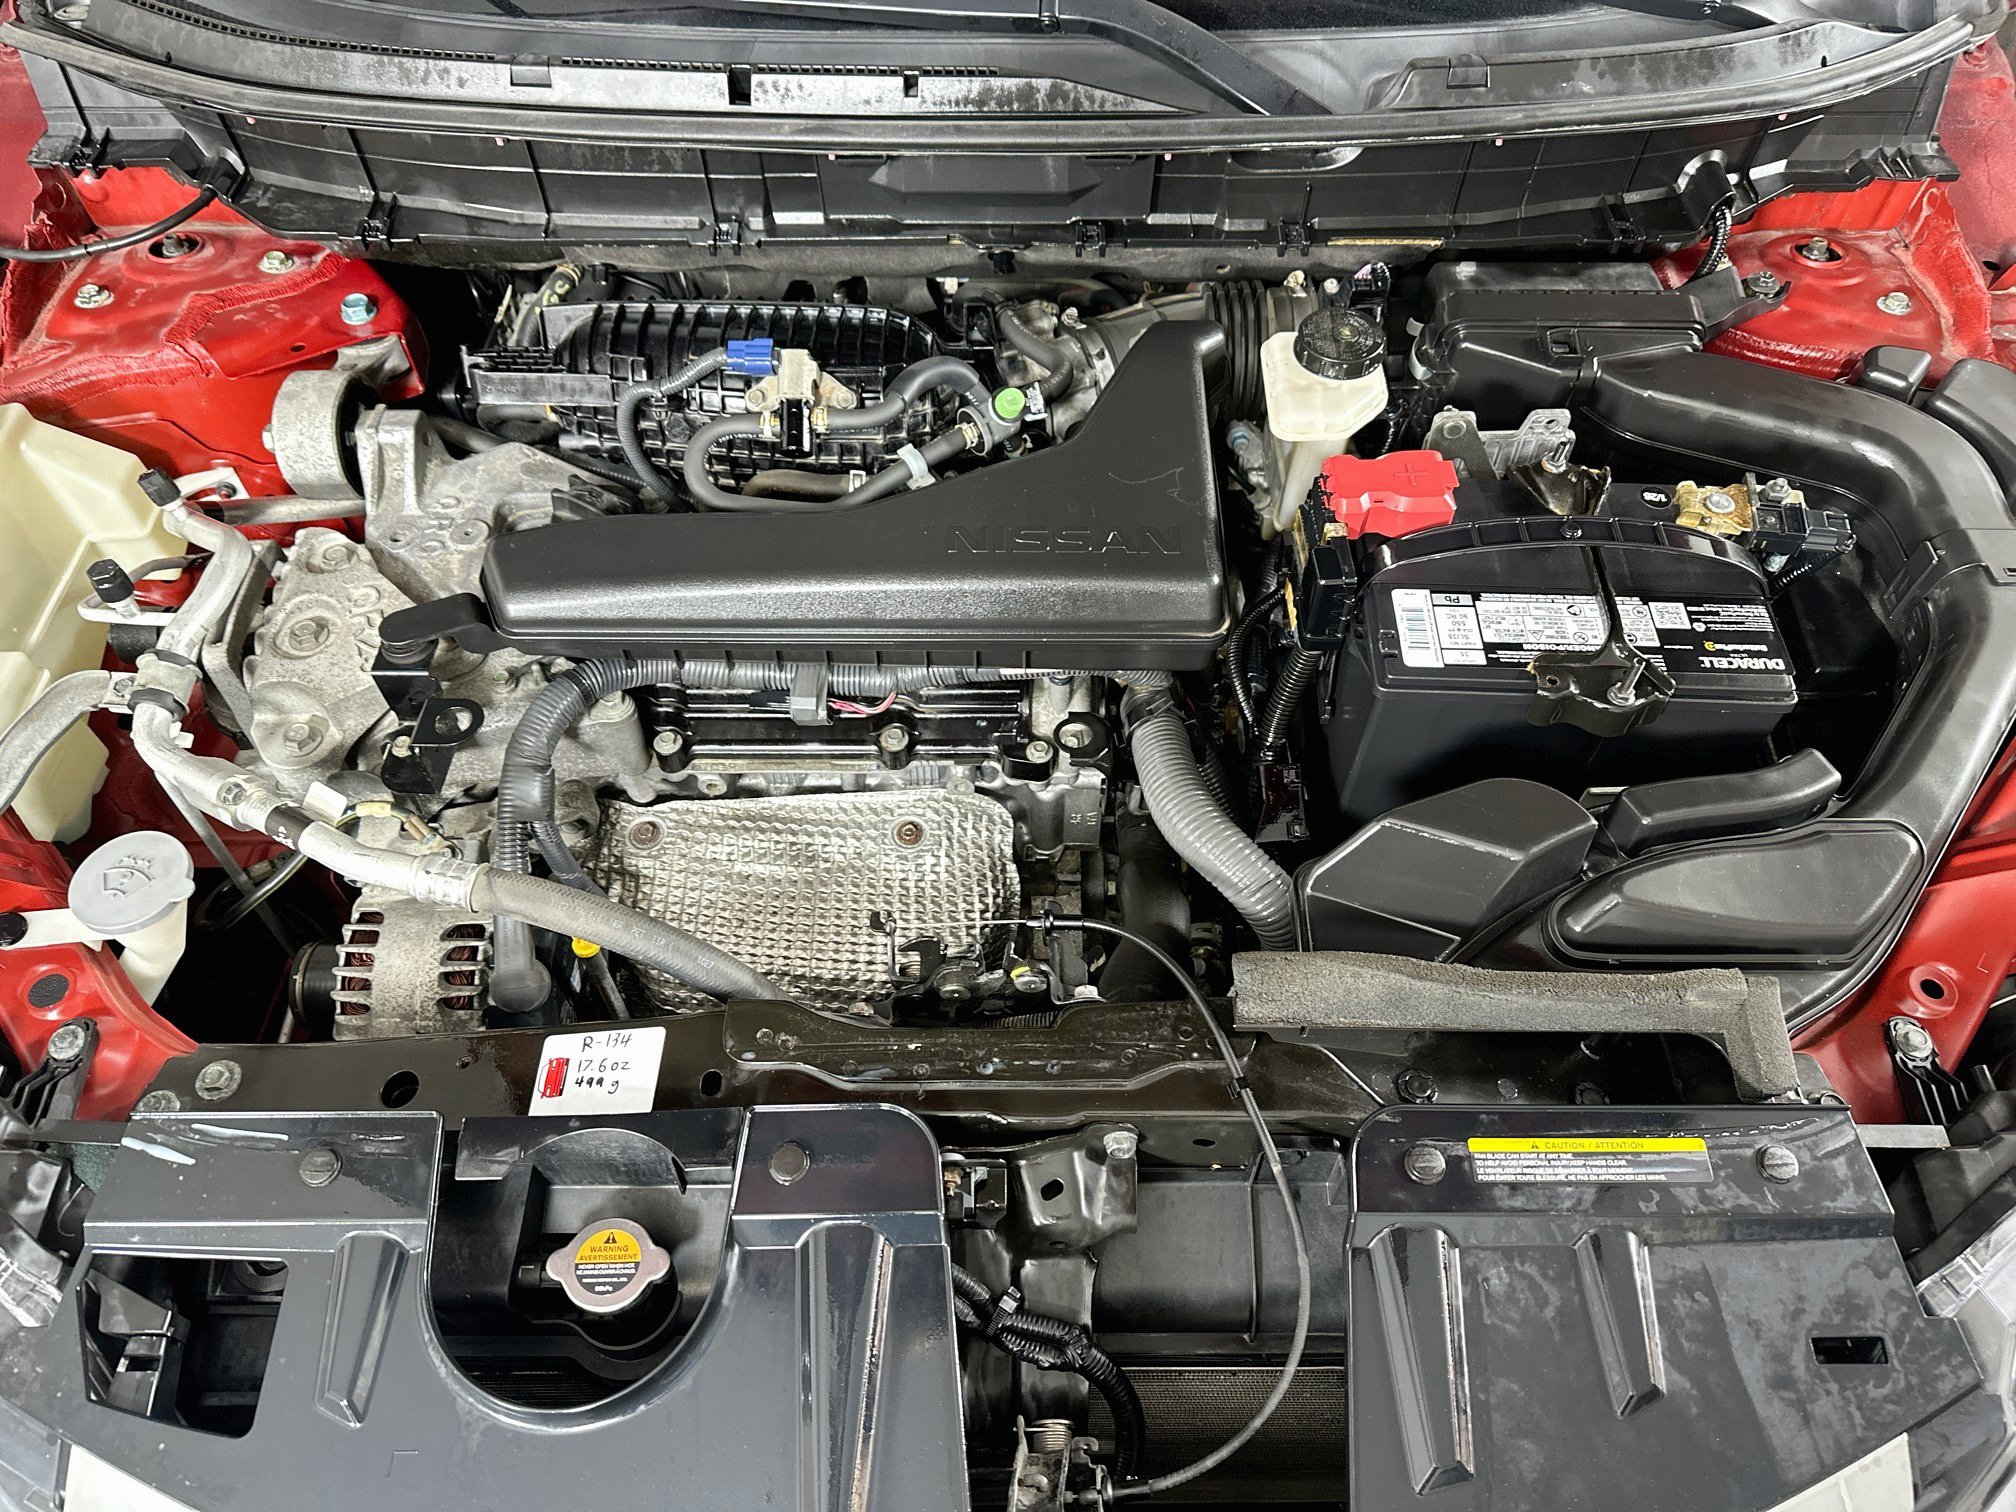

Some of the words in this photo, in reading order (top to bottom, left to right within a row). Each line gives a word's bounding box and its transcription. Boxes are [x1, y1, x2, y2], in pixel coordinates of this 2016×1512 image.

[948, 526, 1181, 554] NISSAN
[1445, 596, 1460, 604] Pb
[1523, 643, 1602, 652] ANGER/POISON
[1698, 657, 1786, 670] DURACELL
[582, 1033, 632, 1052] R-134
[575, 1076, 604, 1088] 499
